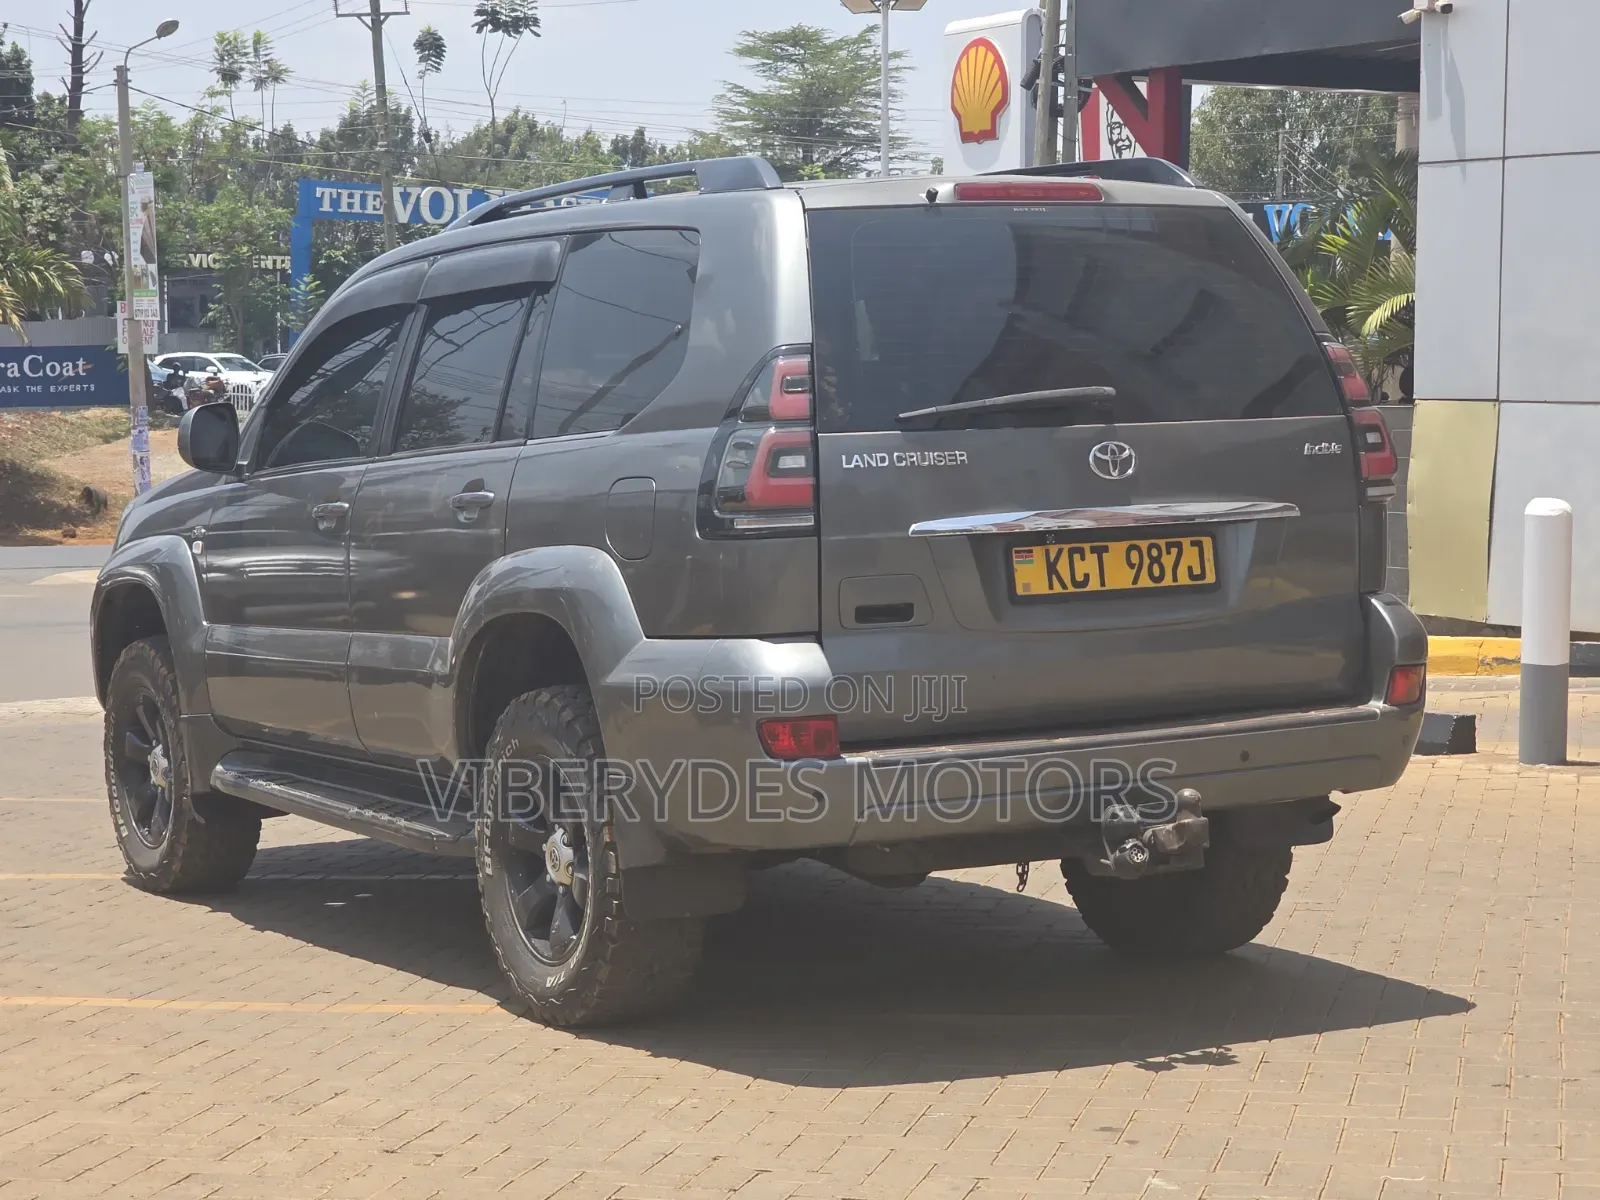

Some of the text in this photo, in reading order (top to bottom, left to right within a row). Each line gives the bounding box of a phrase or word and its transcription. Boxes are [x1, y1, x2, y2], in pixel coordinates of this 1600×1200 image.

[315, 187, 384, 215] THE
[50, 384, 95, 392] EXPERTS
[841, 451, 968, 468] LAND CRUISER
[1045, 540, 1207, 590] KCT 987J
